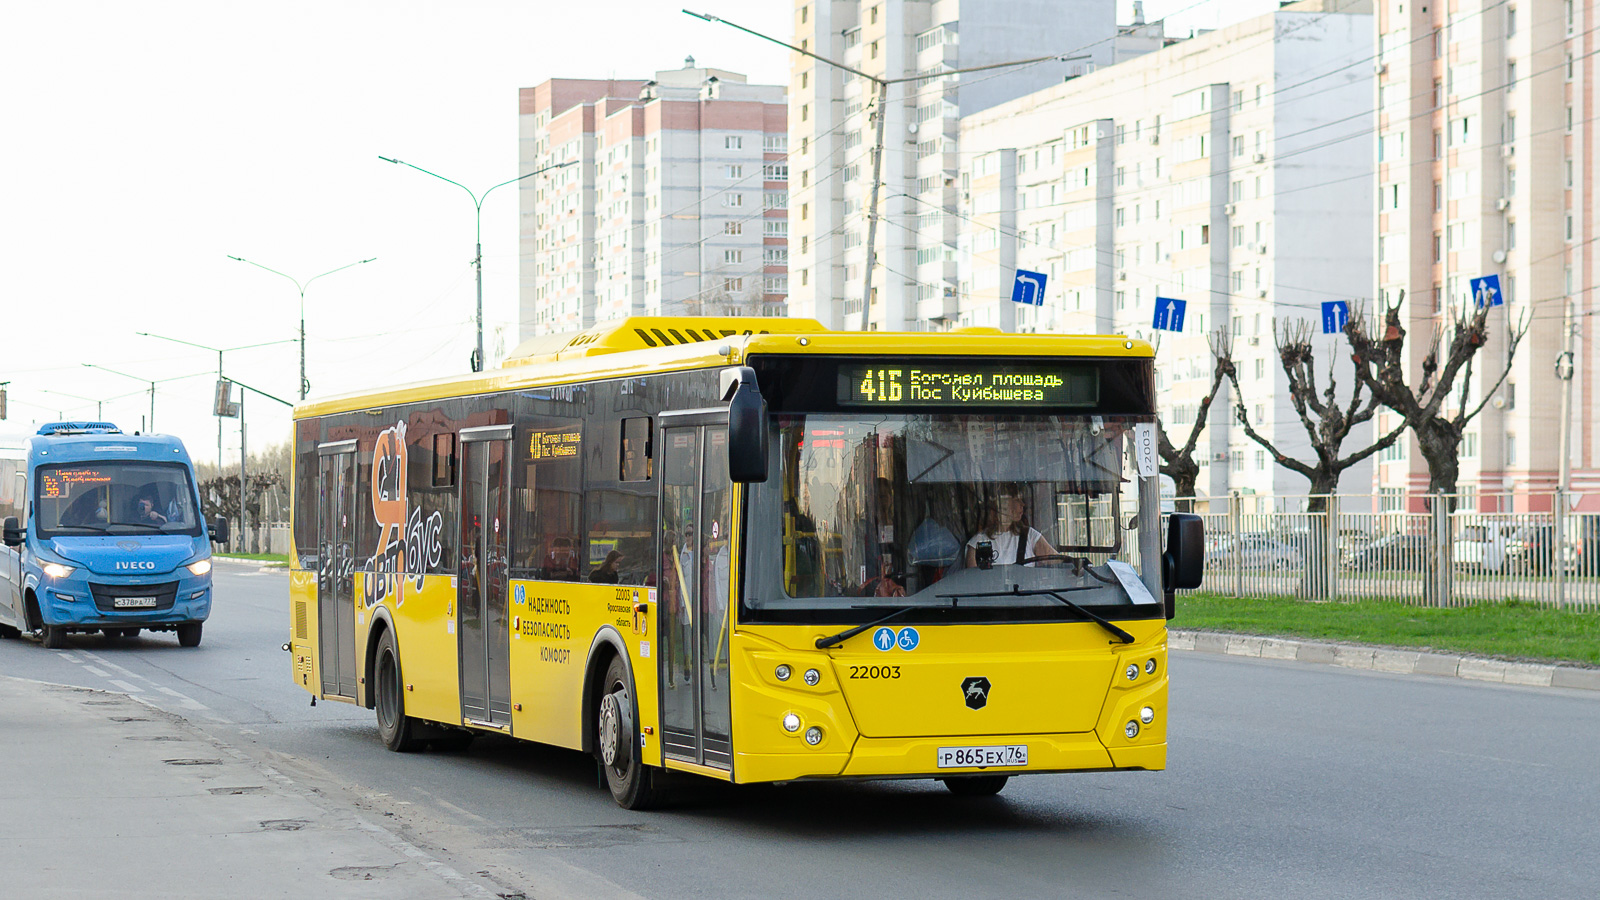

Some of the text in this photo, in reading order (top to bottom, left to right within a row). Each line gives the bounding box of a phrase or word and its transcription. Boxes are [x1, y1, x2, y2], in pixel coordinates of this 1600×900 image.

[860, 369, 902, 401] 41Б
[992, 374, 1064, 388] площадь
[910, 384, 1044, 402] Пос Куйбышева
[1142, 429, 1153, 473] 22003
[116, 561, 155, 570] IVECO
[615, 588, 631, 601] 22003
[528, 597, 571, 615] НАДЕЖНОСТЬ
[607, 602, 631, 614] Ярославская
[616, 617, 631, 628] область
[523, 620, 571, 640] БЕЗОПАСНОСТЬ
[540, 646, 571, 665] КОМФОРТ
[849, 665, 901, 679] 22003
[1007, 747, 1022, 759] 76
